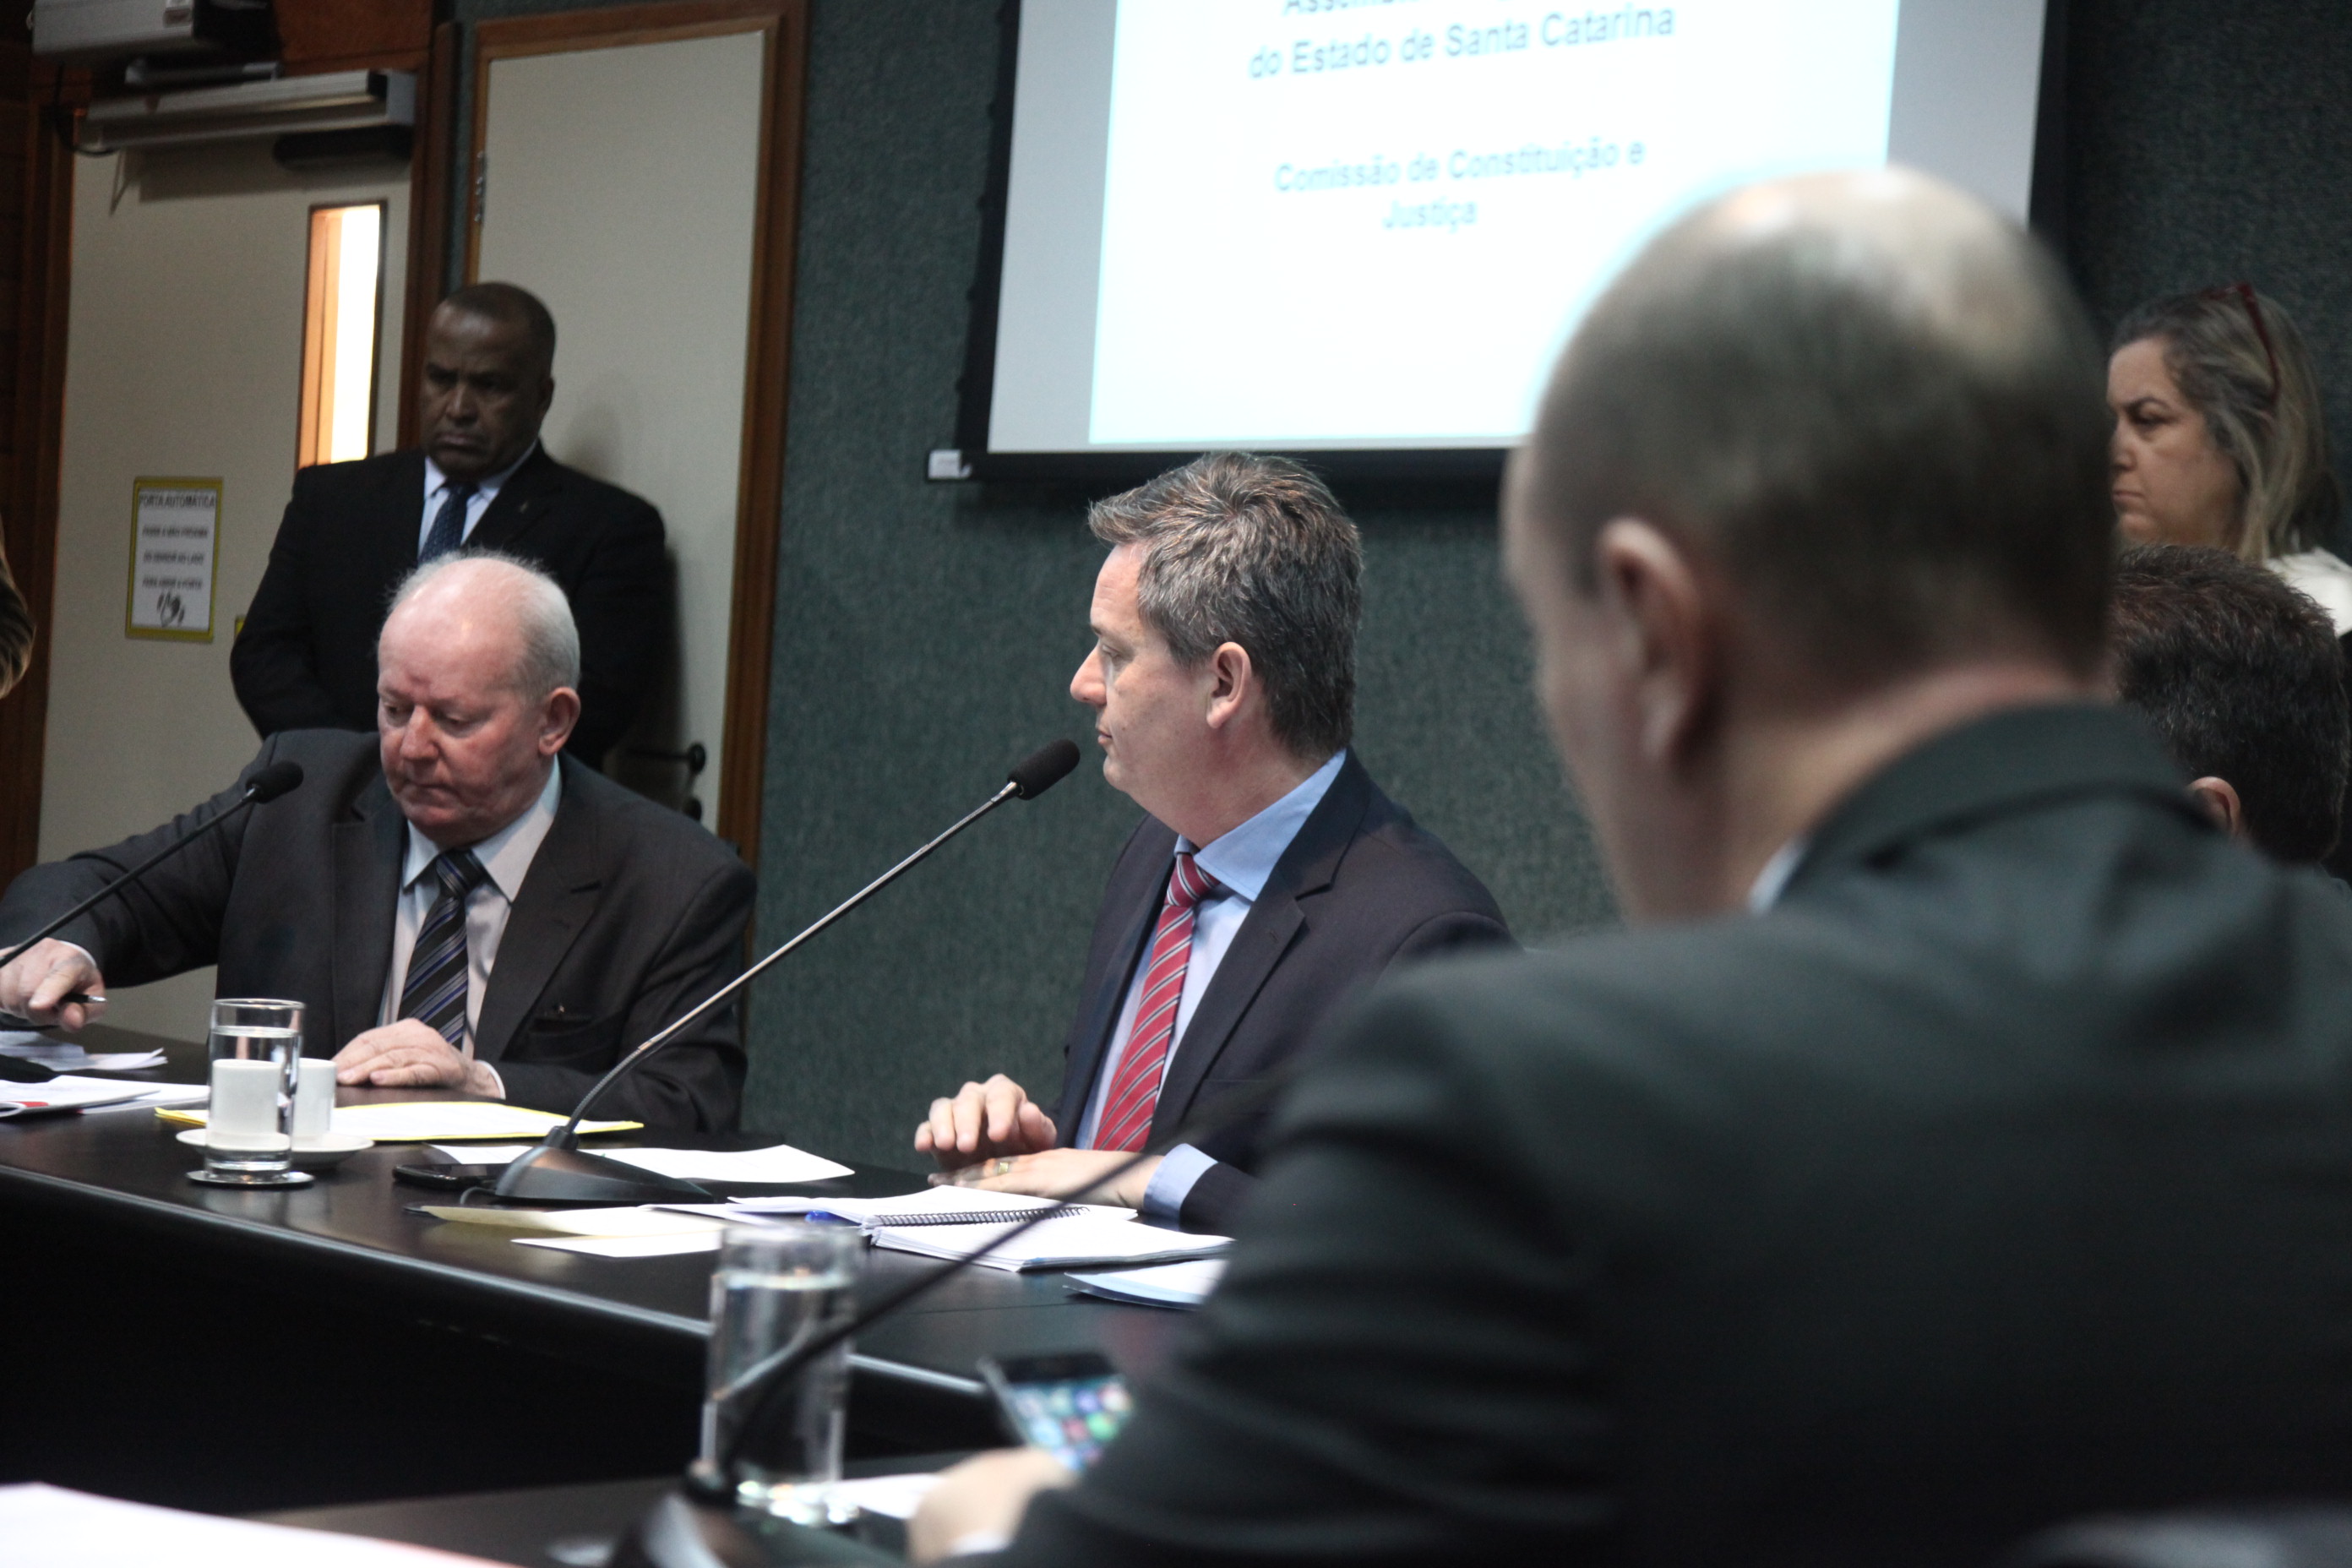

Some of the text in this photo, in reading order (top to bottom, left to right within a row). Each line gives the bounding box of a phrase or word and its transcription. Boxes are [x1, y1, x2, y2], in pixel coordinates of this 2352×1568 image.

[1250, 3, 1676, 79] do Estado de Santa Catarina
[1274, 135, 1647, 192] Comissão de Constituição e
[1382, 196, 1478, 234] Justiça
